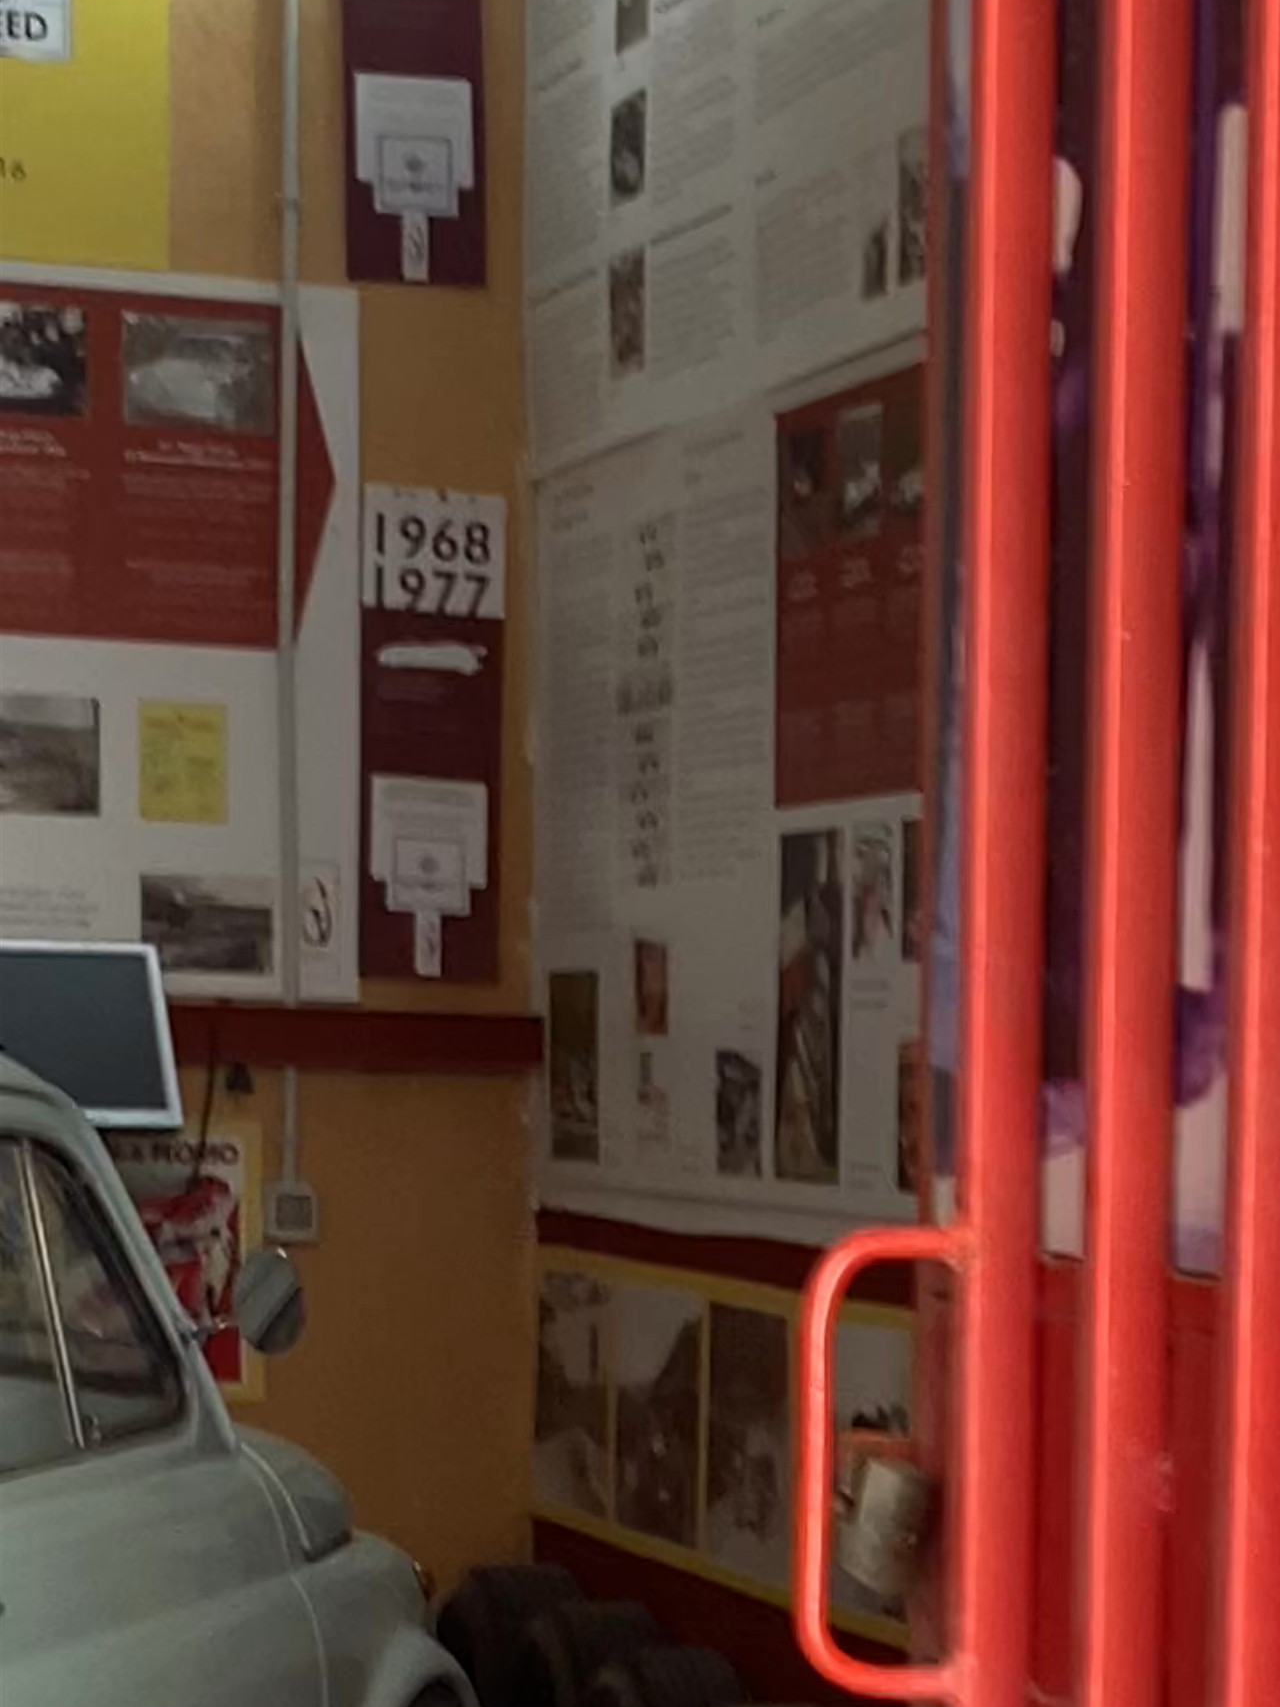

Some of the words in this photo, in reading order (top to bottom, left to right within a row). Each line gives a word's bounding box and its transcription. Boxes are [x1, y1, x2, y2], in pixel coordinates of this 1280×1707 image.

[0, 9, 48, 43] ED
[375, 511, 491, 565] 1968
[375, 562, 489, 617] 1977
